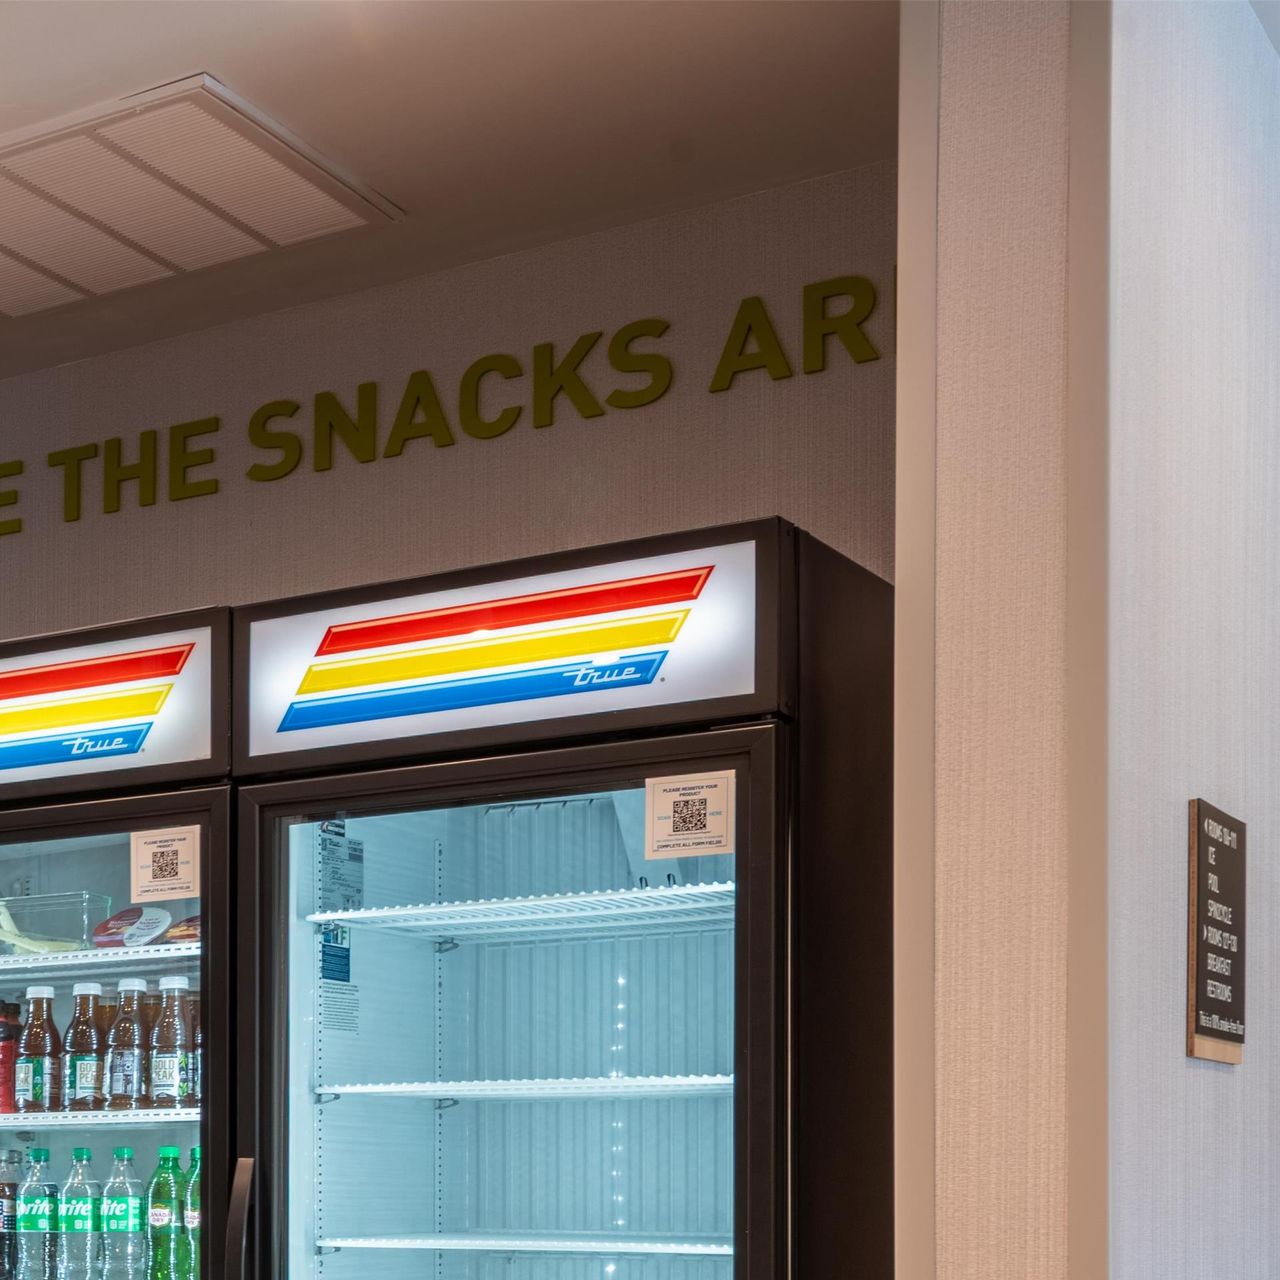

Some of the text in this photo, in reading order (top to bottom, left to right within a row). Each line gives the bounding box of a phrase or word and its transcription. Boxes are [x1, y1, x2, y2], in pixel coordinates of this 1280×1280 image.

[47, 416, 219, 522] THE
[245, 317, 674, 482] SNACKS
[709, 275, 896, 393] AR
[562, 667, 641, 686] true
[62, 737, 128, 754] true
